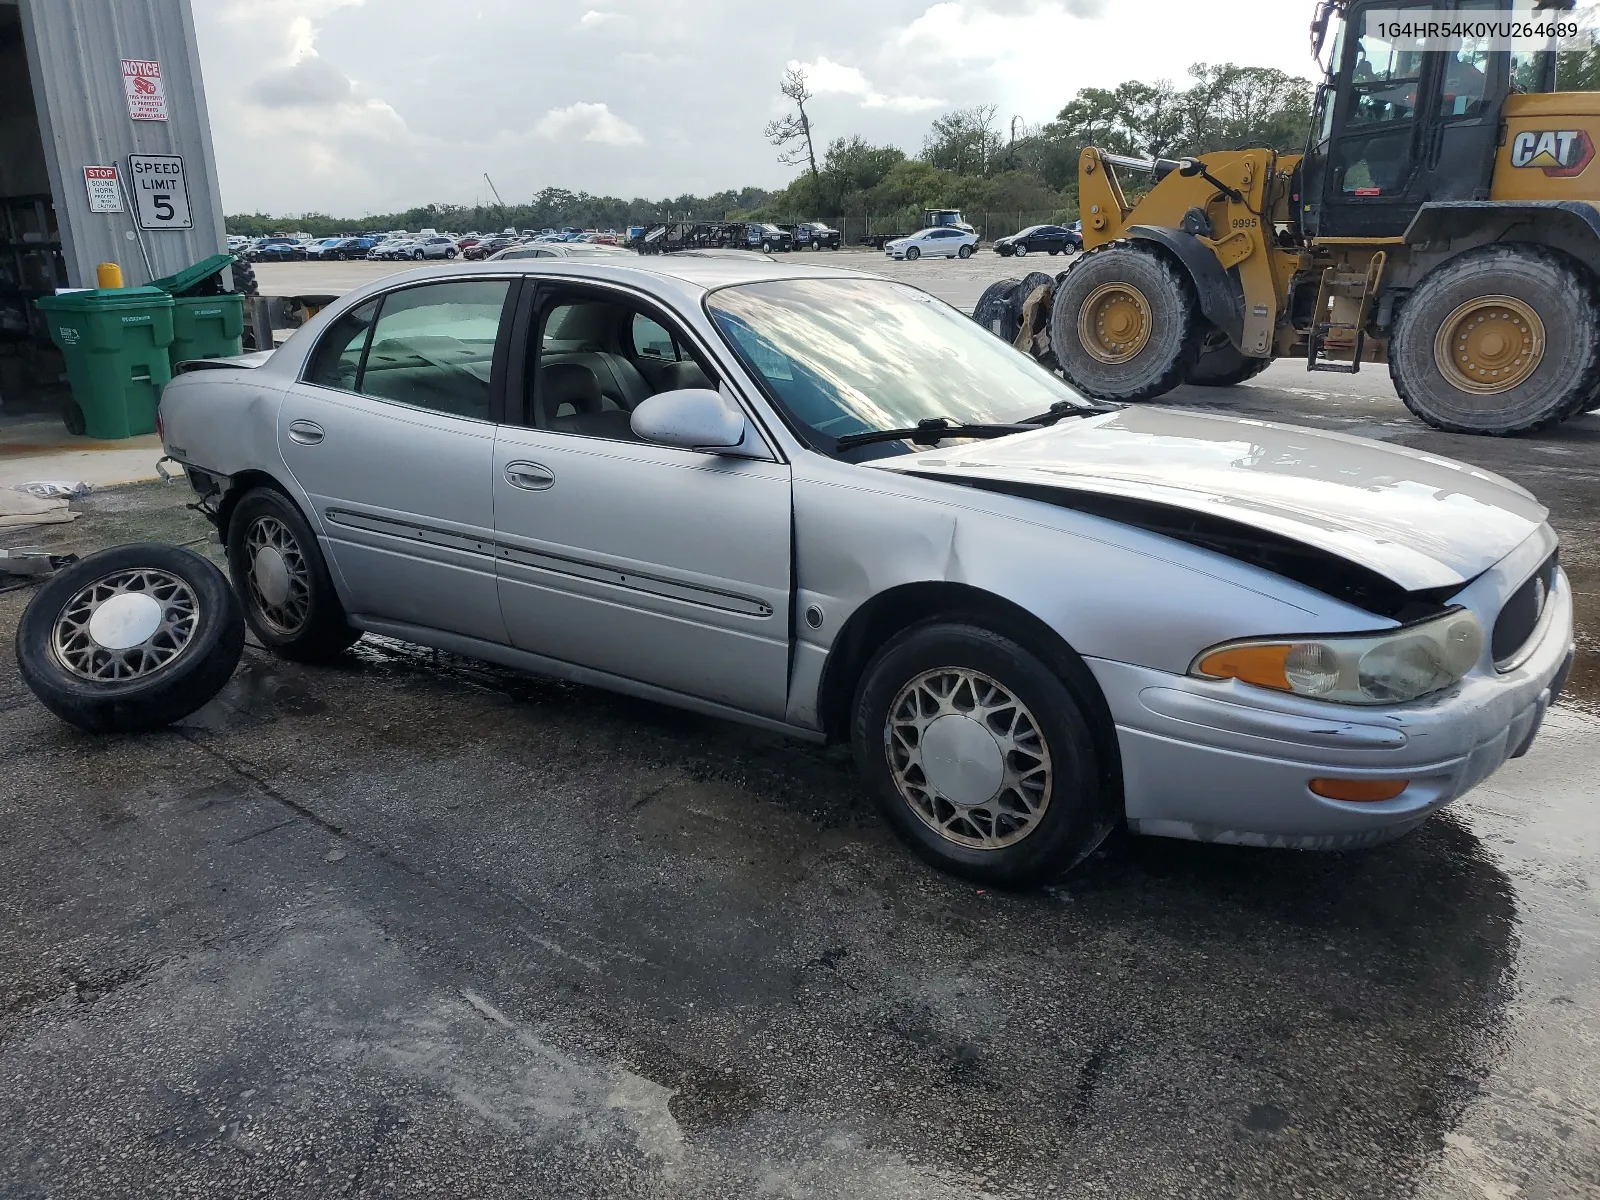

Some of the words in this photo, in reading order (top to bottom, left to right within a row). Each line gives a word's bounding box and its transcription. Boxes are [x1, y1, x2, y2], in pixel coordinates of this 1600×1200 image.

[122, 61, 160, 76] NOTICE
[1512, 131, 1577, 167] CAT
[88, 169, 113, 178] STOP
[135, 162, 180, 174] SPEED
[142, 178, 177, 190] LIMIT
[153, 194, 175, 221] 5
[1232, 218, 1257, 229] 9995
